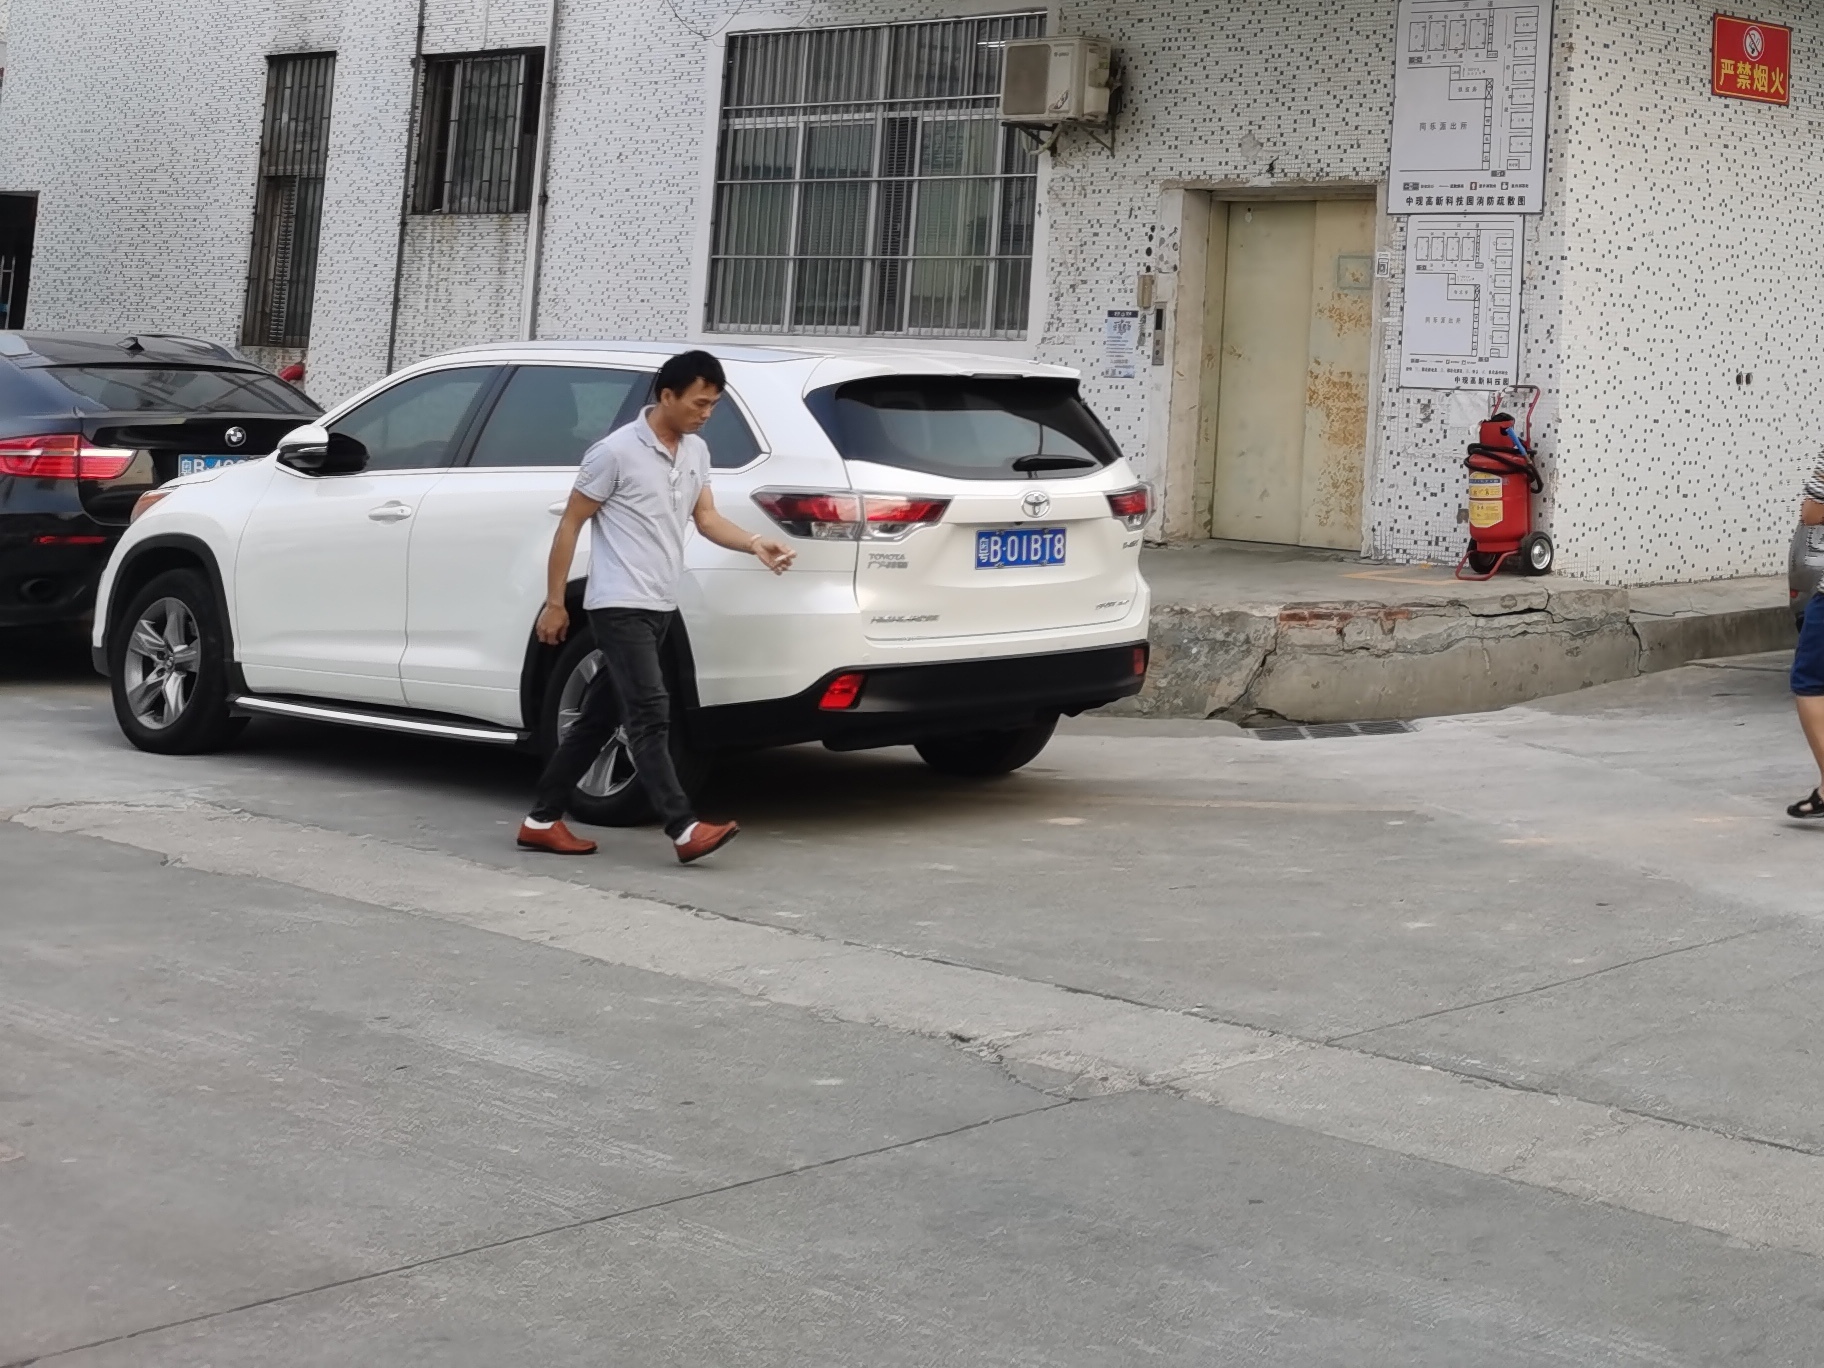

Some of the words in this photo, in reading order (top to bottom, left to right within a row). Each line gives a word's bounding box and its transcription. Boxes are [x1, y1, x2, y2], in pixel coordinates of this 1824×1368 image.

[1719, 58, 1784, 95] 严禁烟火
[868, 553, 906, 561] TOYOTA
